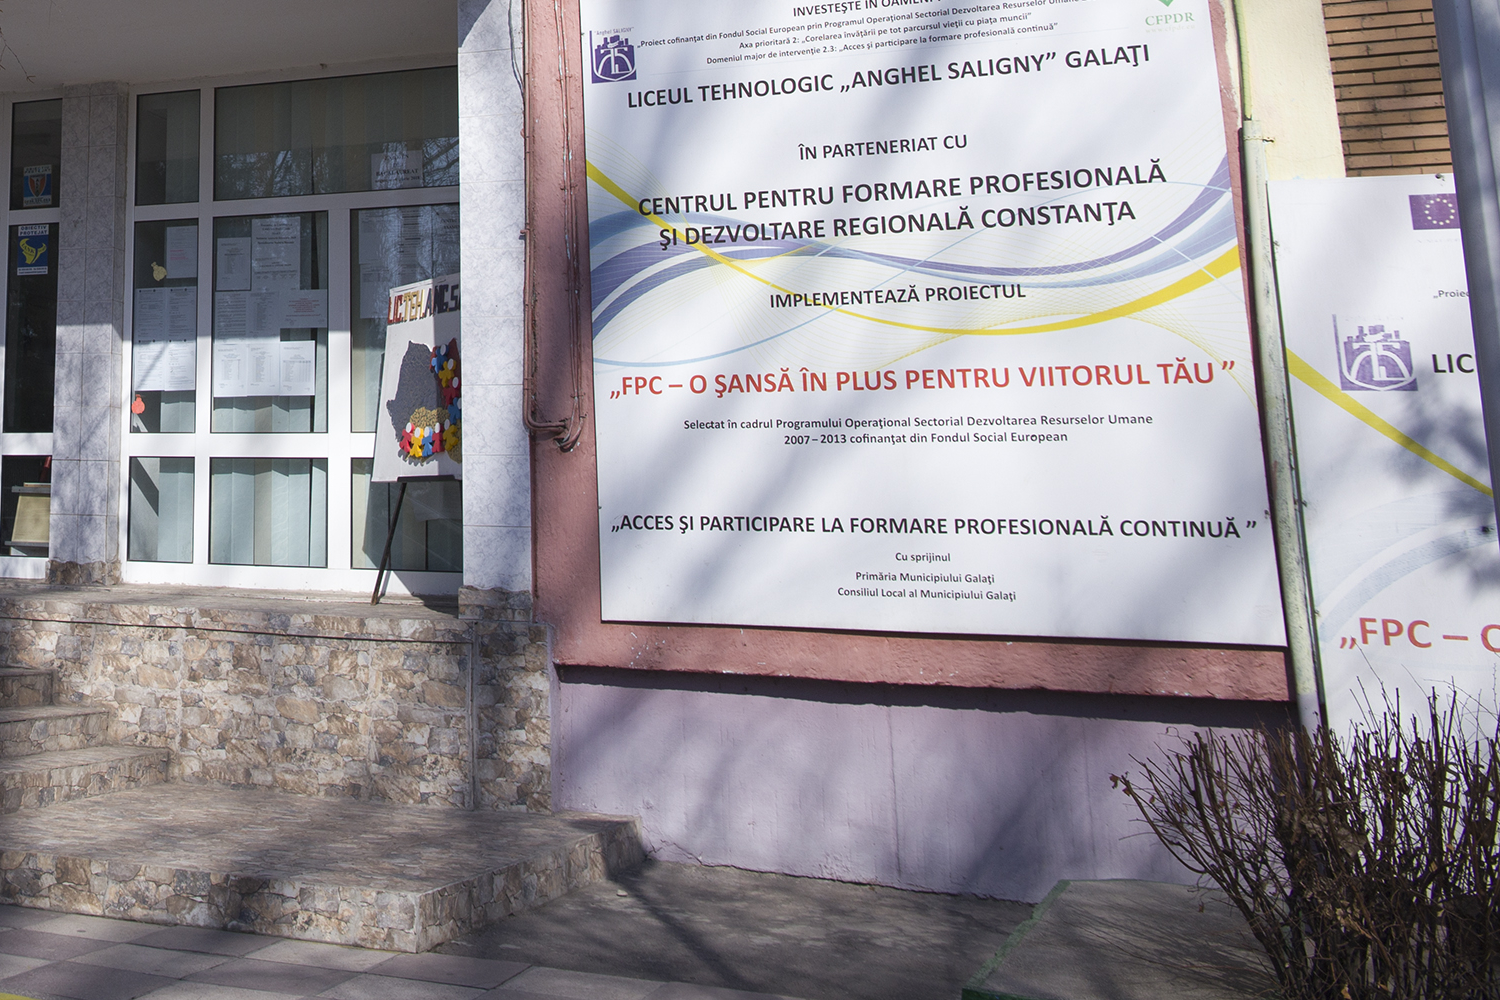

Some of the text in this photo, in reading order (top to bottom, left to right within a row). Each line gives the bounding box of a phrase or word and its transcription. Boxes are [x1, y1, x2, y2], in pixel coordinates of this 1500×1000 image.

[793, 0, 861, 16] INVESTEŞTE
[1145, 11, 1195, 27] CFPDR
[628, 87, 692, 107] LICEUL
[697, 74, 833, 101] TEHNOLOGIC
[798, 134, 966, 160] ÎN PARTENERIAT CU
[638, 158, 1166, 215] CENTRUL PENTRU FORMARE PROFESIONALĂ
[685, 219, 825, 245] DEZVOLTARE
[833, 205, 974, 236] REGIONALĂ
[770, 283, 1026, 307] IMPLEMENTEAZĂ PROIECTUL
[689, 374, 706, 393] O
[799, 366, 826, 391] ÎN
[836, 370, 896, 390] PLUS
[905, 367, 1009, 389] PENTRU
[1018, 364, 1150, 386] VIITORUL
[1156, 356, 1213, 383] TĂU
[684, 419, 724, 429] Selectat
[726, 419, 737, 428] în
[740, 418, 772, 428] cadrul
[776, 417, 841, 430] Programului
[914, 416, 963, 426] Sectorial
[966, 415, 1036, 425] Dezvoltarea
[1040, 414, 1104, 424] Resurselor
[1108, 414, 1152, 424] Umane
[909, 432, 927, 442] din
[930, 432, 969, 442] Fondul
[973, 431, 1006, 442] Social
[1010, 432, 1067, 443] European
[700, 516, 814, 532] PARTICIPARE
[821, 517, 844, 532] LA
[850, 517, 947, 533] FORMARE
[954, 515, 1113, 535] PROFESIONALĂ
[1120, 516, 1240, 537] CONTINUĂ
[895, 552, 950, 563] Cu sprijinul
[855, 571, 961, 583] Primăria Municipiului
[837, 587, 982, 600] Consiliul Local al Municipiului
